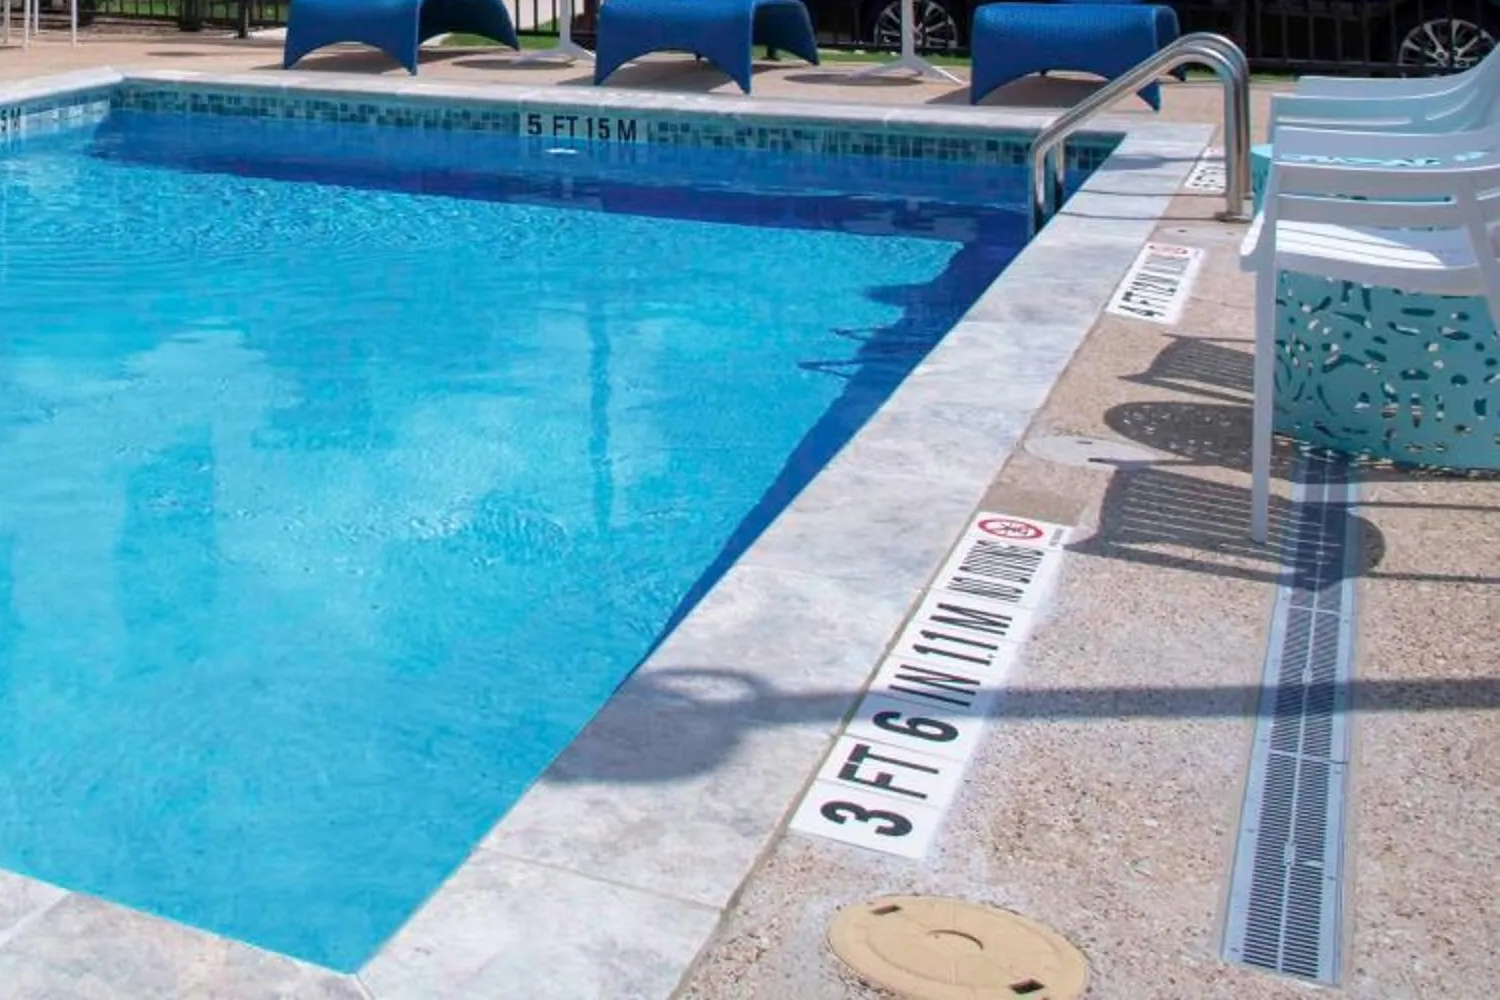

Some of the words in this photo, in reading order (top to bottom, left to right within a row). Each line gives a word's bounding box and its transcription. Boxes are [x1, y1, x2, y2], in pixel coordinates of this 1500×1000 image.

[527, 113, 543, 136] 5
[552, 115, 579, 138] FT
[617, 119, 637, 142] M
[928, 602, 1013, 636] M
[888, 663, 981, 707] IN
[872, 710, 959, 743] 6
[837, 743, 940, 800] FT
[820, 800, 913, 837] 3
